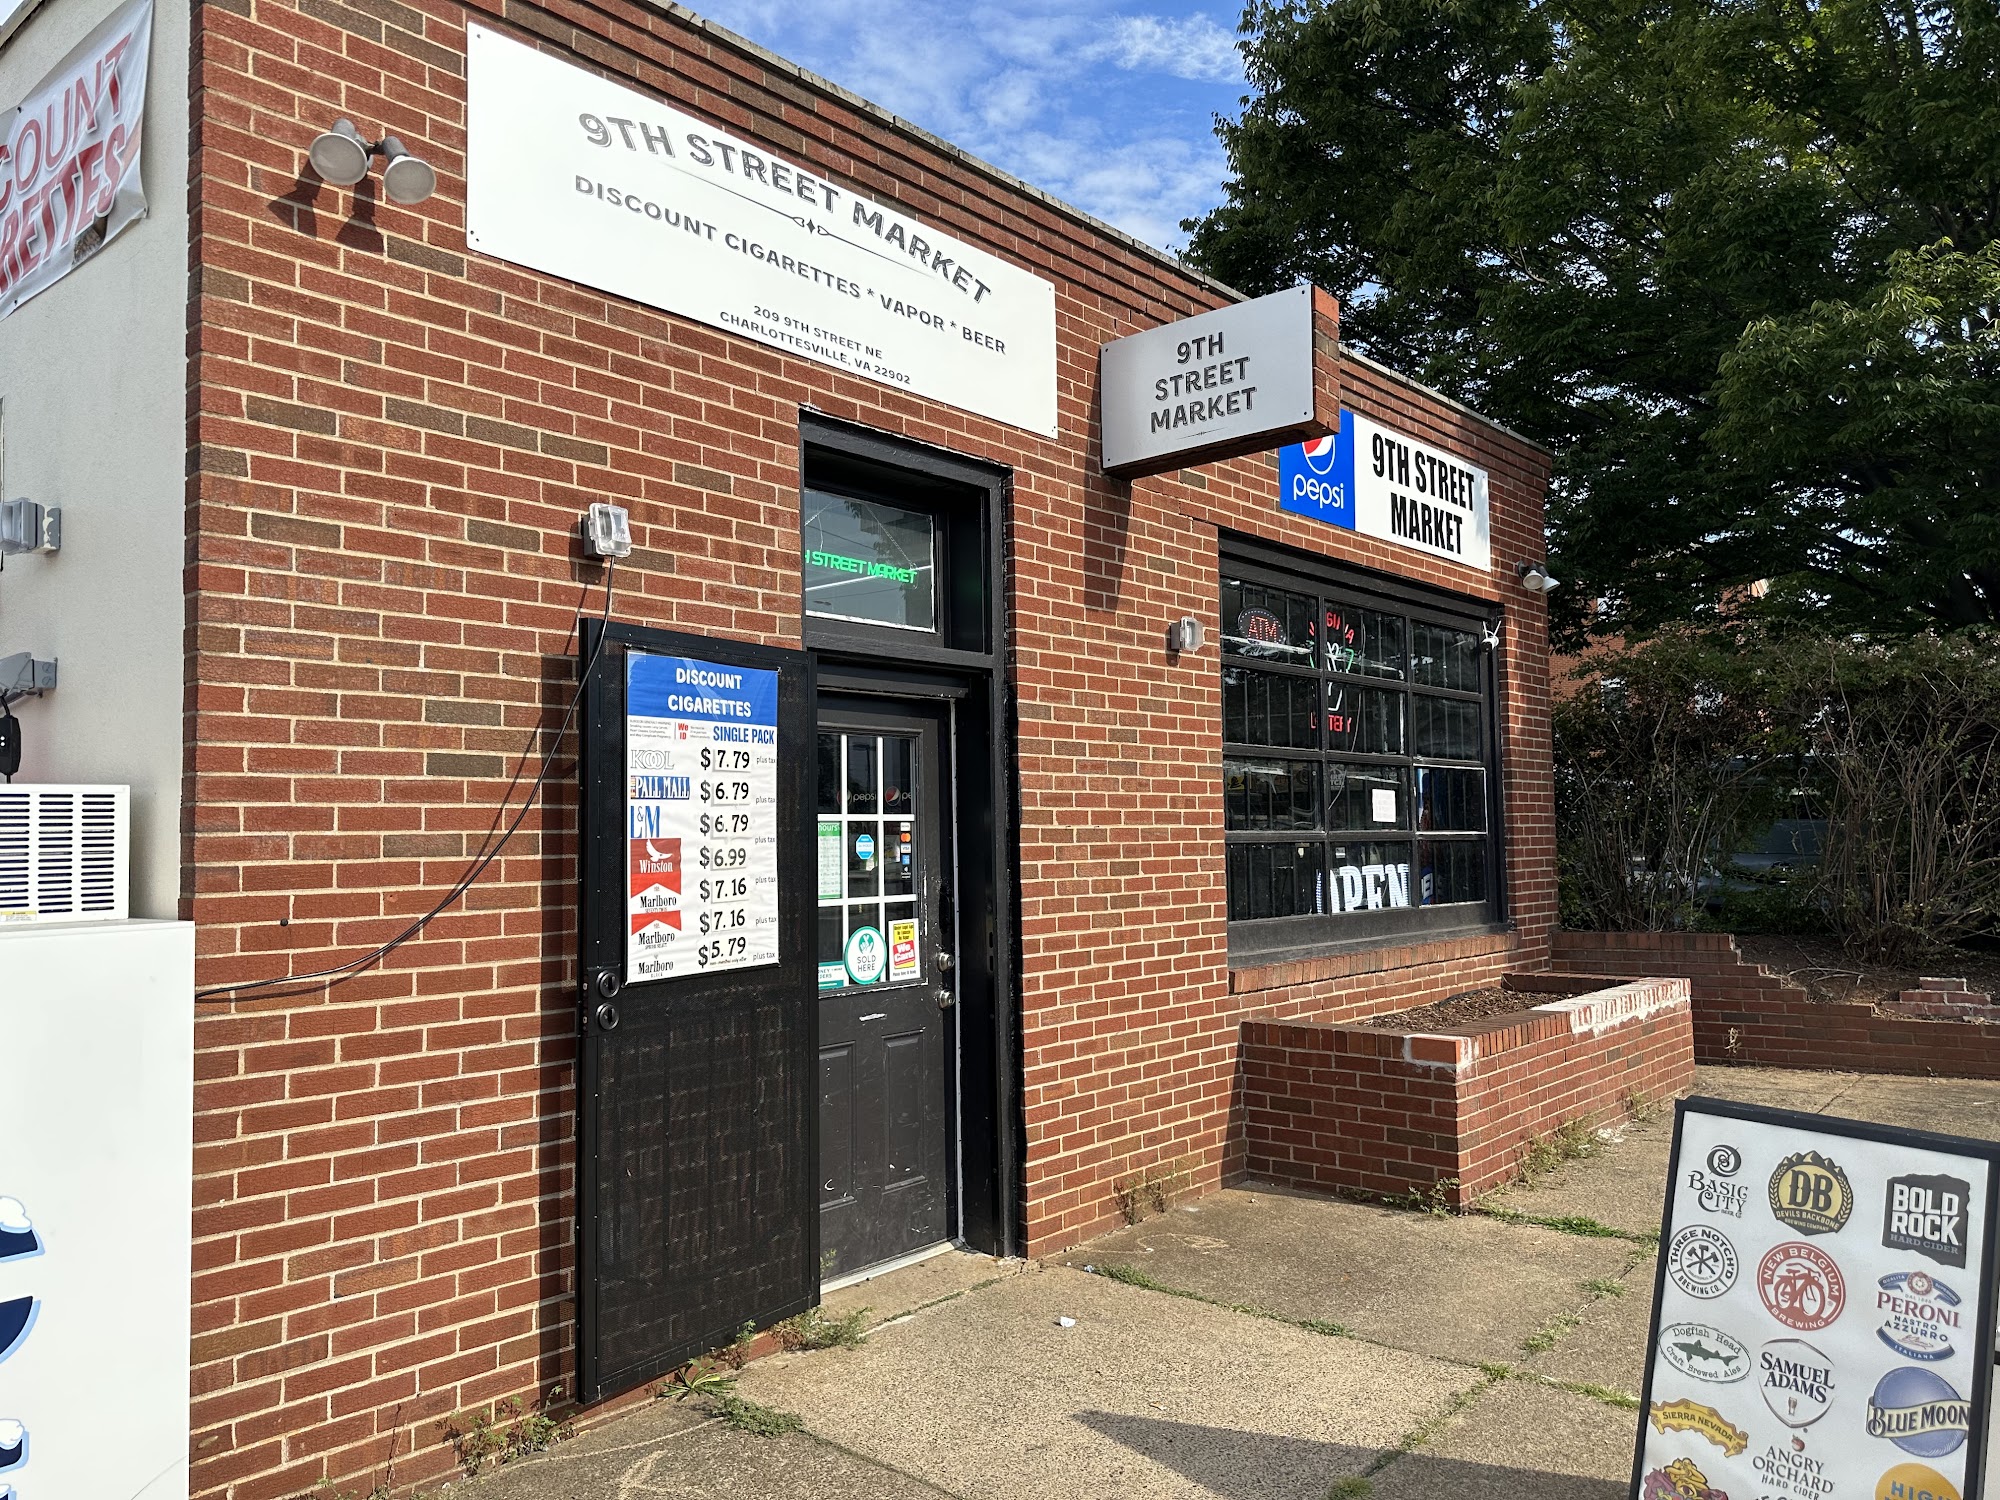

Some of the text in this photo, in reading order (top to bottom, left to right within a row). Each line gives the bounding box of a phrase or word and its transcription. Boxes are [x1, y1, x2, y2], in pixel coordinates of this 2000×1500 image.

[579, 113, 992, 304] 9TH STREET MARKET
[575, 175, 1006, 355] DISCOUNT CIGARETTES VAPOR BEER
[753, 305, 882, 359] 209 9TH STREET NE
[720, 311, 911, 385] CHARLOTTESVILLE, VA 22902
[1176, 331, 1226, 365] 9TH
[1155, 356, 1251, 401] STREET
[1150, 386, 1257, 433] MARKET
[1372, 433, 1475, 512] 9TH STREET
[1293, 473, 1344, 509] pepsi
[1390, 492, 1463, 555] MARKET
[812, 551, 867, 574] STREET
[867, 562, 917, 584] MARKET
[1248, 615, 1277, 643] ATM
[676, 668, 742, 690] DISCOUNT
[668, 695, 752, 717] CIGARETTES
[678, 723, 689, 732] We
[680, 732, 687, 740] ID
[713, 726, 775, 744] SINGLE PACK
[630, 749, 675, 770] KOOL
[757, 756, 768, 764] plus
[636, 776, 690, 799] PALL MALL
[853, 793, 876, 802] pepsi
[755, 796, 768, 804] plus
[630, 805, 660, 838] L&M
[754, 836, 767, 844] plus
[639, 860, 673, 873] Winston
[755, 876, 768, 884] plus
[640, 895, 677, 908] Marlboro
[755, 916, 768, 926] plus
[638, 932, 675, 945] Marlboro
[897, 943, 911, 954] We
[638, 960, 673, 975] Marlboro
[753, 952, 767, 961] plus
[857, 955, 876, 964] SOLD
[857, 964, 875, 972] HERE
[1787, 1169, 1833, 1212] DB
[1892, 1183, 1959, 1216] BOLD
[1776, 1210, 1839, 1230] DEVILS BACKBONE
[1785, 1218, 1829, 1231] BREWING COMPANY
[1891, 1211, 1960, 1246] ROCK
[1670, 1229, 1734, 1279] THREE NOTCH'D
[1890, 1234, 1958, 1255] HARD CIDER
[1763, 1248, 1839, 1296] NEW BELGIUM
[1678, 1276, 1709, 1294] BREWING
[1771, 1307, 1825, 1328] BREWING
[1877, 1291, 1961, 1328] PERONI
[1884, 1320, 1948, 1342] AZZURRO
[1894, 1315, 1938, 1331] NASTRO
[1672, 1327, 1741, 1355] Dogfish Head
[1894, 1345, 1934, 1359] ITALIANA
[1666, 1346, 1741, 1378] Craft Brewed Ales
[1760, 1352, 1836, 1389] SAMUEL
[1764, 1371, 1827, 1404] ADAMS
[1662, 1412, 1733, 1442] SIERRA NEVADA
[1867, 1404, 1970, 1437] BLUE MOON
[1765, 1446, 1824, 1475] ANGRY
[1752, 1456, 1834, 1493] ORCHARD
[1761, 1474, 1819, 1500] HARD CIDER
